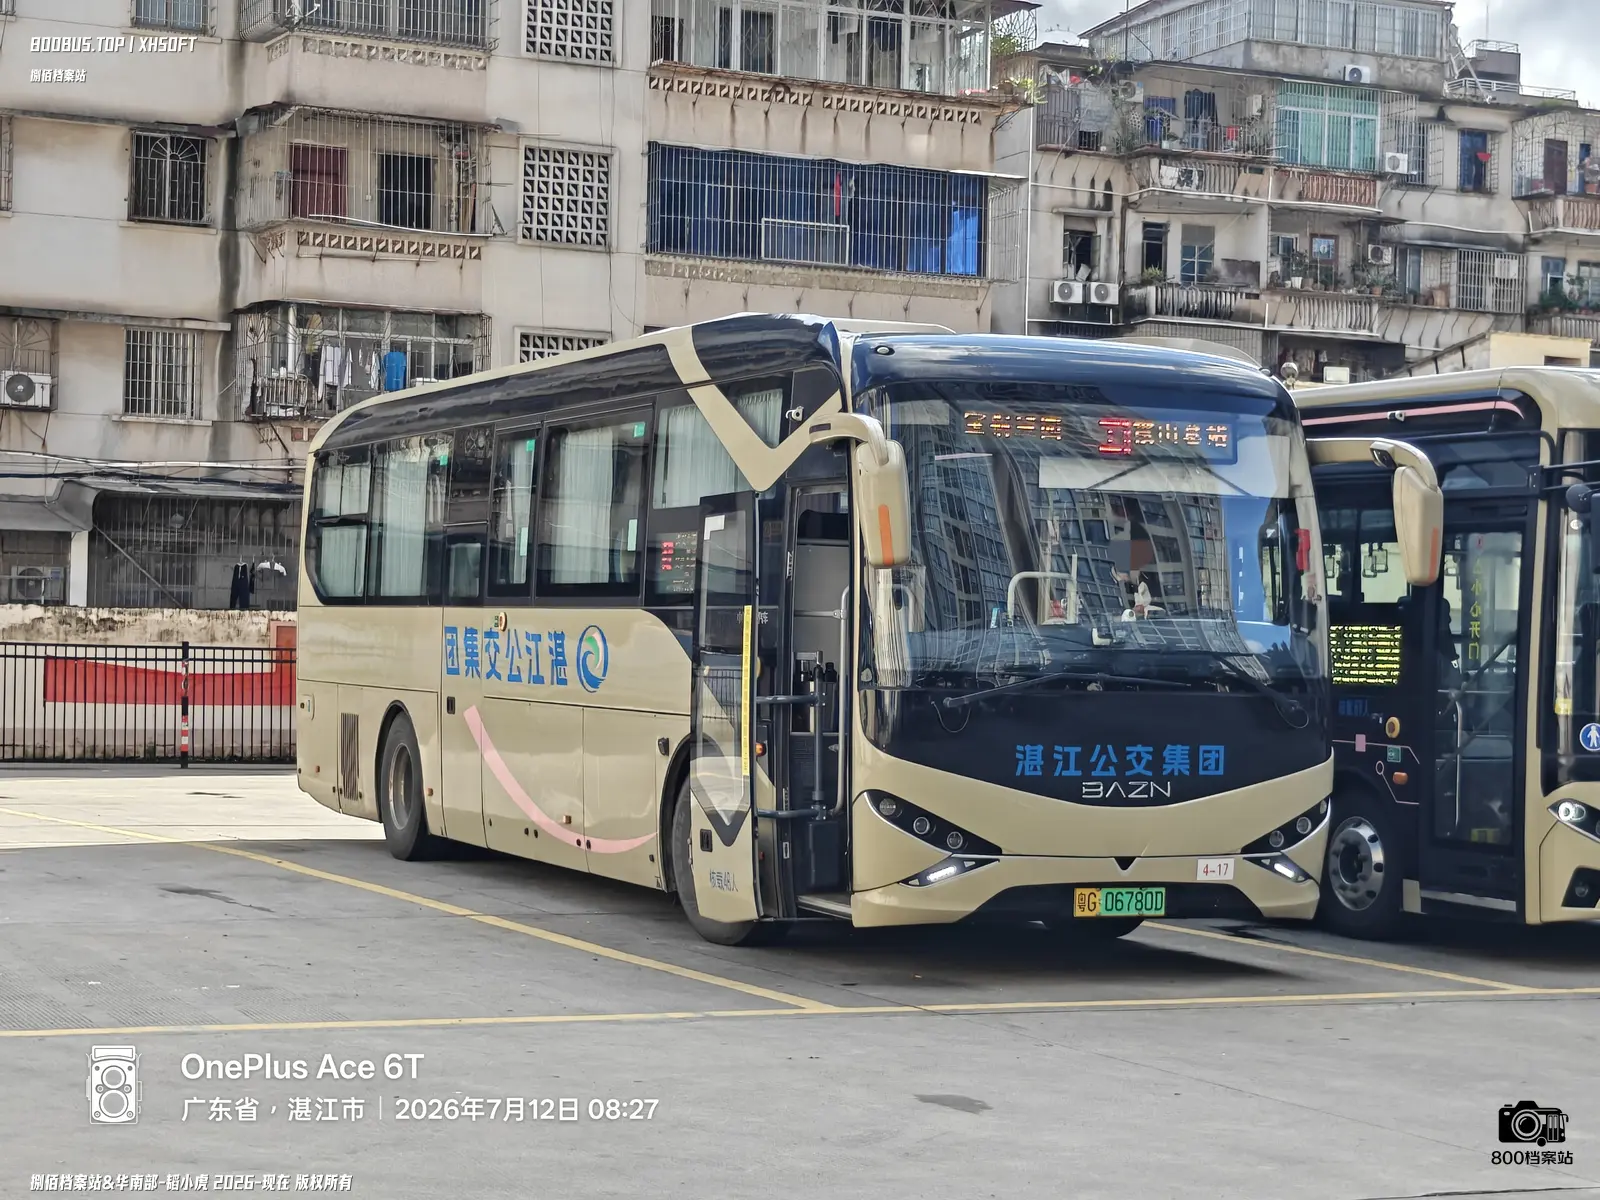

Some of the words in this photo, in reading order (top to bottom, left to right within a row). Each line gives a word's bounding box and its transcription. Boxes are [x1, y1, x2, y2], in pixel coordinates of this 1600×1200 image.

[1016, 744, 1225, 777] 湛江公交集团
[1082, 781, 1172, 799] BAZN
[1202, 863, 1230, 877] 4-17
